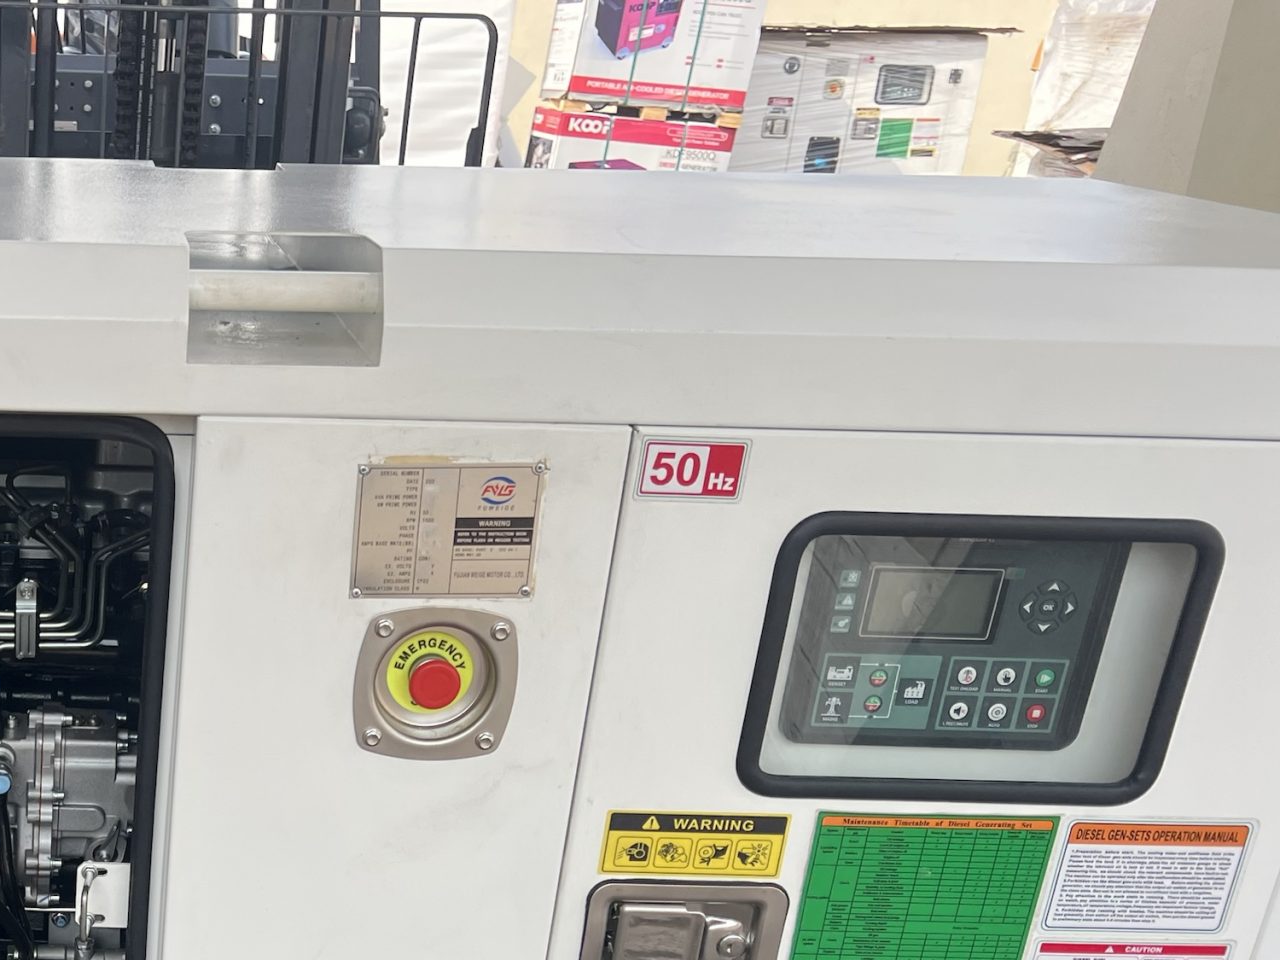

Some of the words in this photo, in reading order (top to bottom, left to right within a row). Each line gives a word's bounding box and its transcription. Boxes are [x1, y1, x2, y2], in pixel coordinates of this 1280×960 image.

[629, 2, 656, 12] KOP
[650, 452, 701, 486] 50
[707, 472, 735, 491] Hz
[394, 637, 466, 670] EMERGENCY
[673, 818, 754, 831] WARNING
[1076, 829, 1105, 840] DIESEL
[1107, 829, 1151, 841] GEN-SETS
[1152, 831, 1202, 842] OPERATION
[1202, 832, 1239, 843] MANUAL
